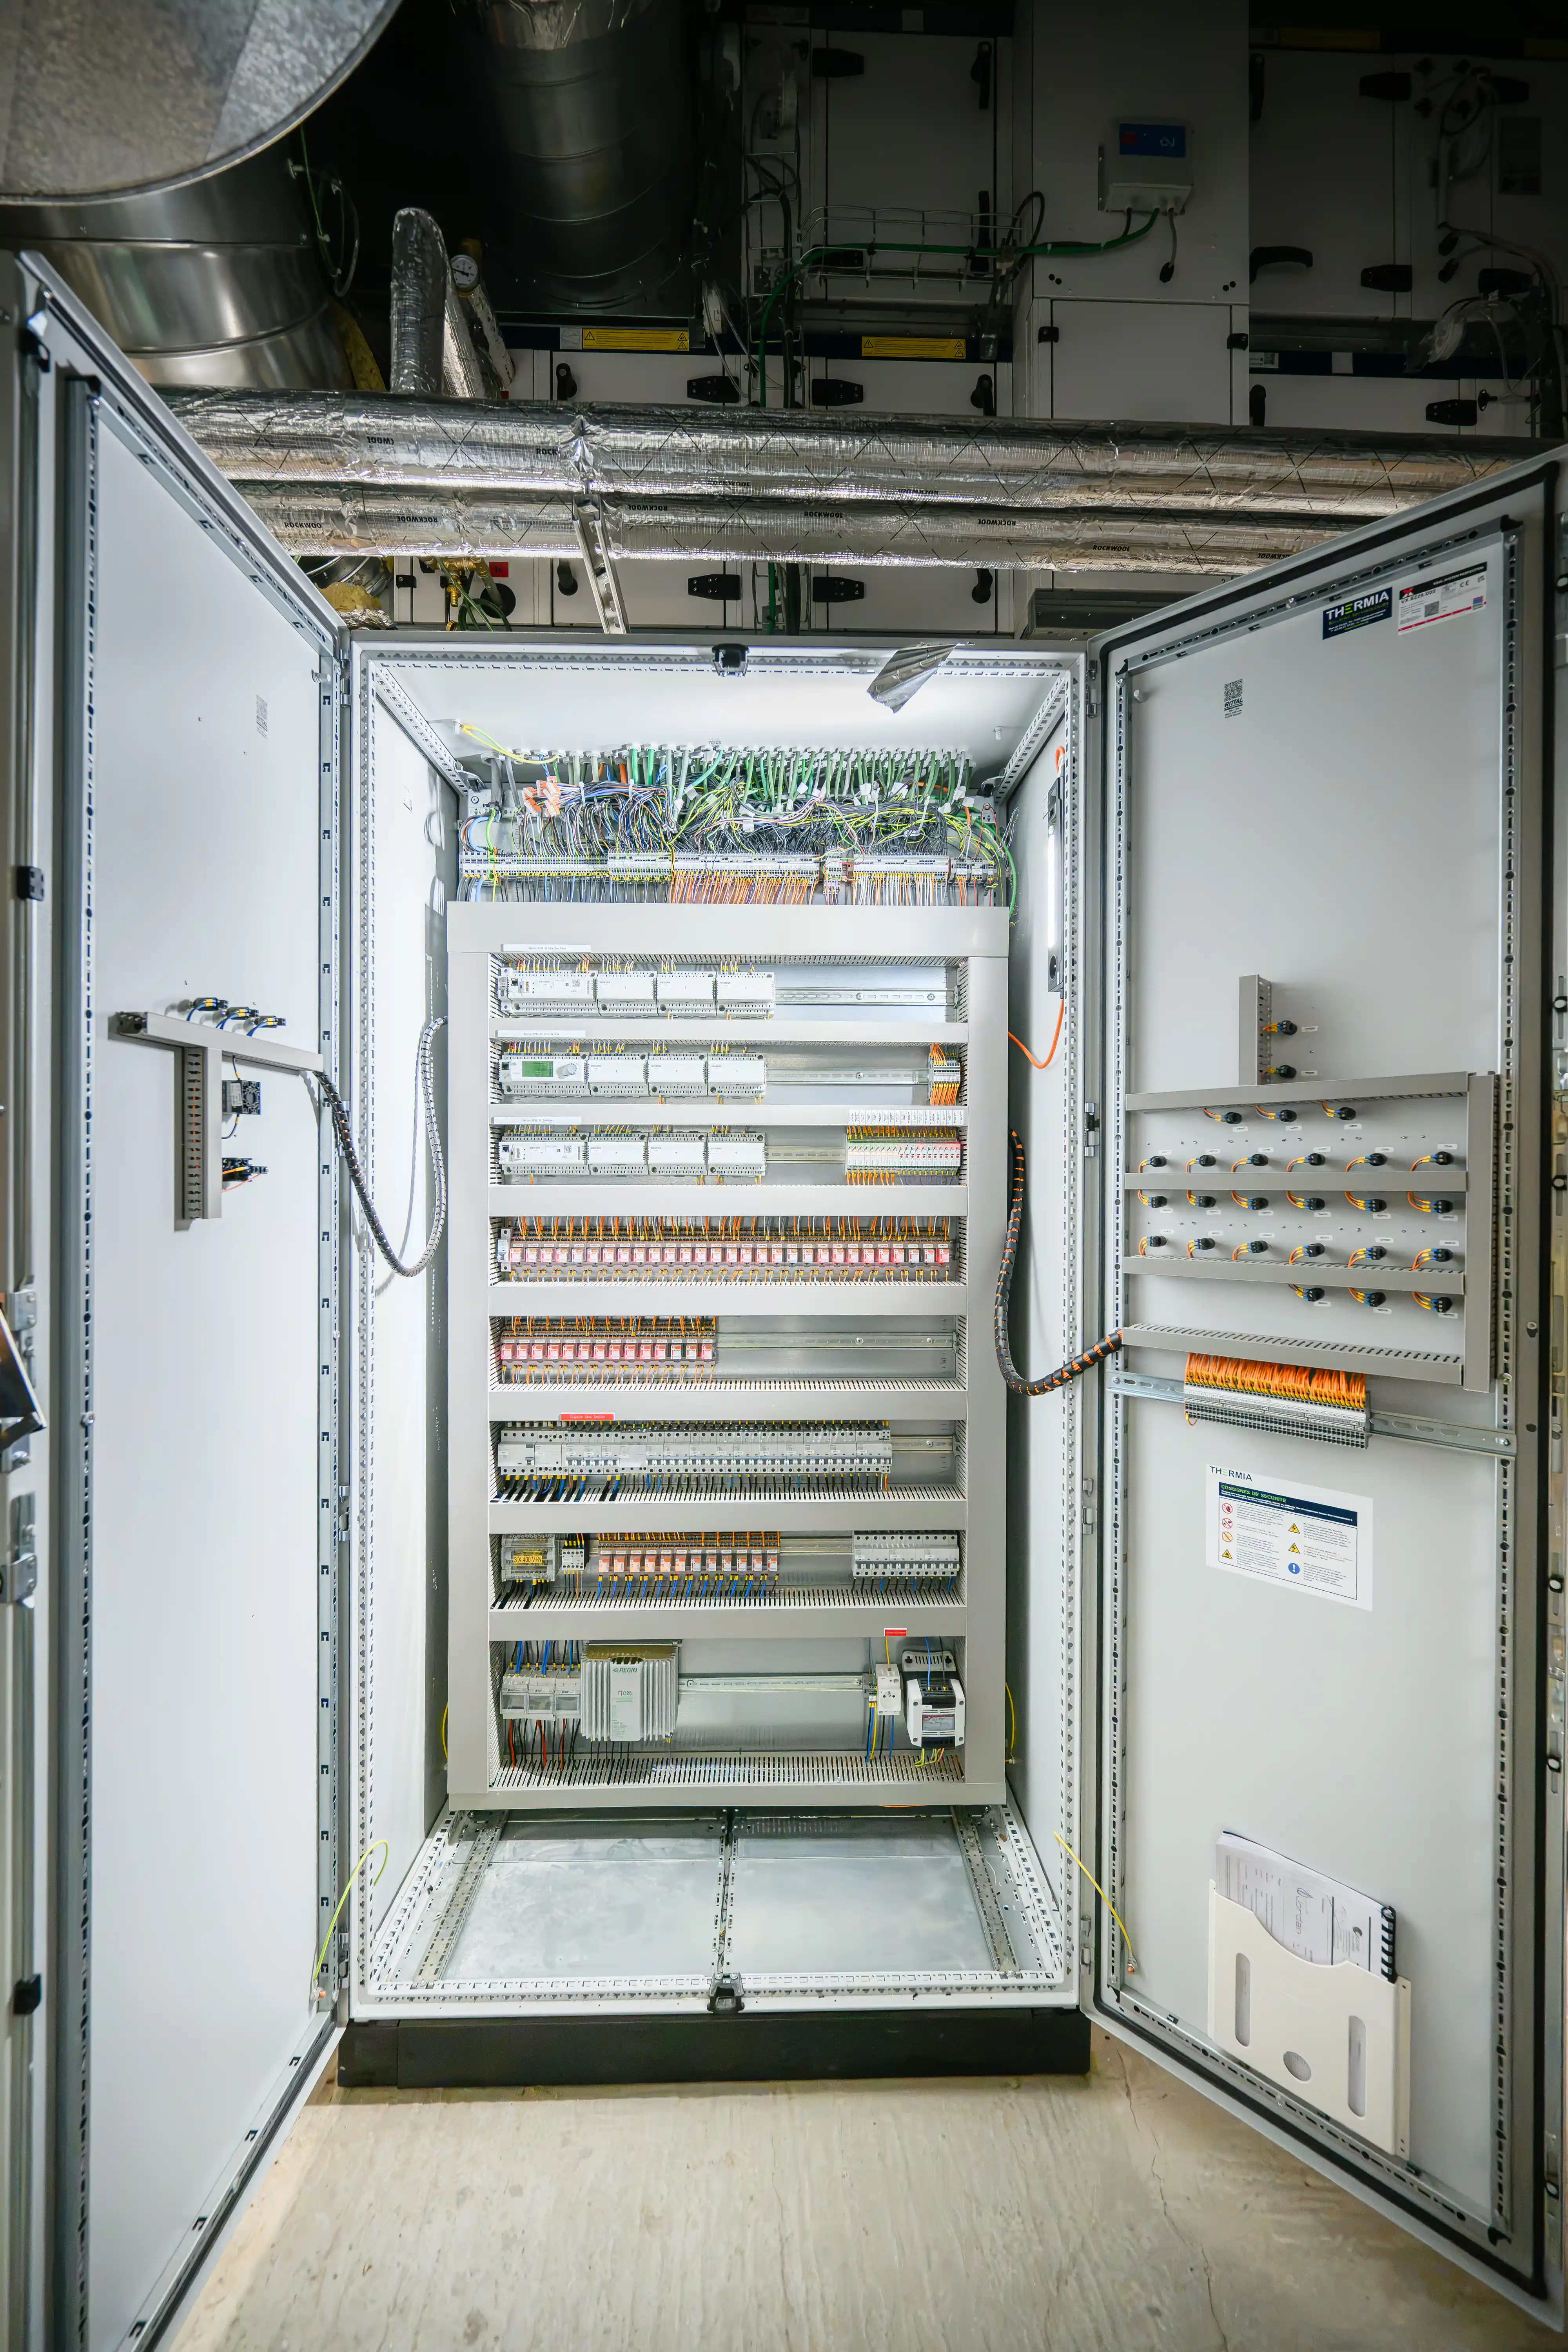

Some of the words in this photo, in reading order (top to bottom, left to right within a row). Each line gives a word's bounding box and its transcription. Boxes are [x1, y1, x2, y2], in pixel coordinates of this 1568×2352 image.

[1326, 591, 1389, 620] THERMIA
[1224, 697, 1243, 708] RITTAL
[1210, 1466, 1252, 1481] THERMIA
[1221, 1485, 1250, 1495] CONSIGNES
[1295, 1896, 1303, 1935] Jordan
